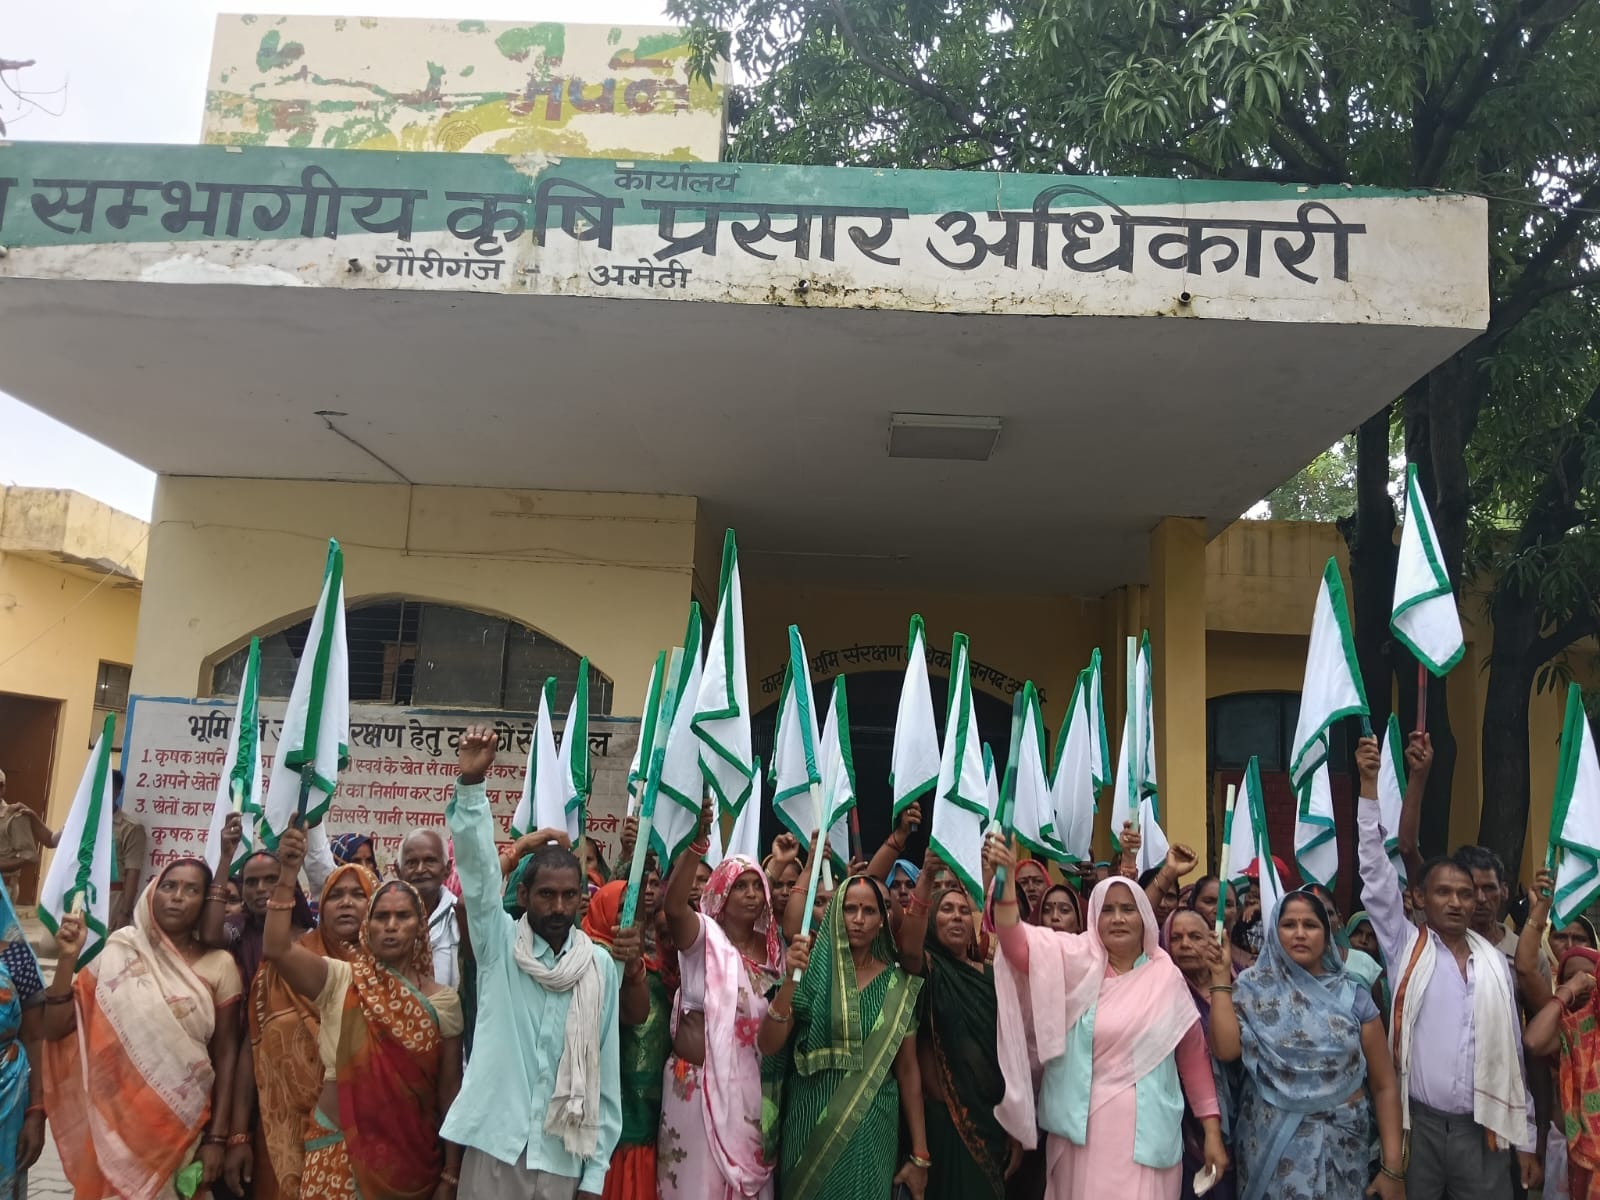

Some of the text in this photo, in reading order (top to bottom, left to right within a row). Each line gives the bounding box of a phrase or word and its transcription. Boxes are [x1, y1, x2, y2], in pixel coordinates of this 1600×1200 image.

[614, 164, 739, 193] कार्यालय
[31, 165, 428, 242] सम्भागीय
[446, 177, 625, 256] कृषि
[641, 199, 909, 266] प्रसार
[926, 184, 1366, 284] अधिकारी
[375, 248, 506, 281] गौरीगंज
[588, 257, 692, 289] अमेठी
[841, 643, 903, 664] संरक्षण
[188, 710, 233, 743] भूमि
[409, 719, 444, 757] हेतु
[141, 749, 152, 763] 1.
[155, 749, 192, 767] कृषक
[194, 747, 227, 766] अपने
[383, 756, 399, 774] के
[400, 755, 424, 775] खेत
[426, 759, 440, 776] से
[136, 772, 150, 788] 2.
[153, 770, 190, 789] अपने
[346, 784, 366, 798] का
[368, 781, 409, 799] निर्माण
[409, 786, 432, 801] कर
[135, 798, 147, 814] 3.
[152, 796, 179, 815] खेतों
[182, 801, 201, 816] का
[328, 804, 371, 824] जिससे
[373, 806, 403, 825] पानी
[152, 826, 195, 845] कृषक
